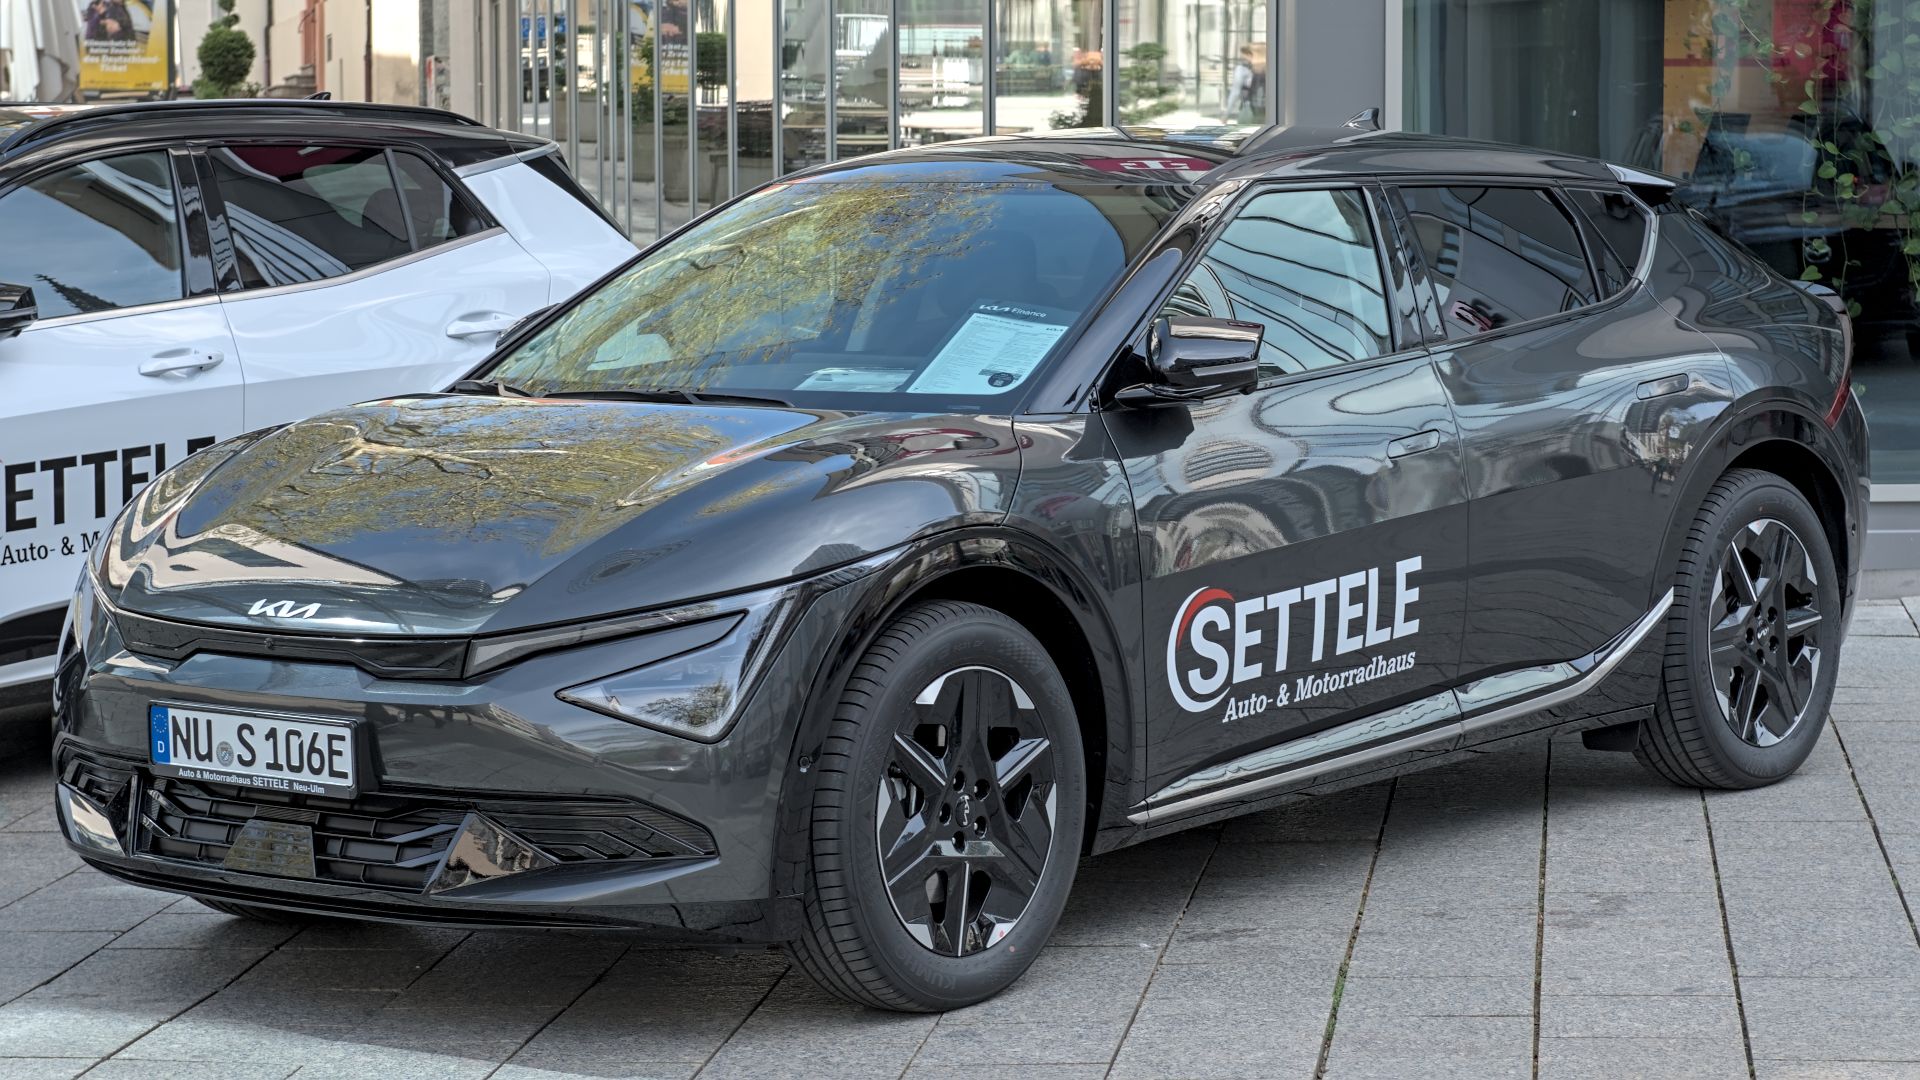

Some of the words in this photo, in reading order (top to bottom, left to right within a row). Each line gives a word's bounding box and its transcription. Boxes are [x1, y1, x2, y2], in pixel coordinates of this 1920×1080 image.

[1011, 307, 1048, 318] Finance
[0, 542, 56, 566] Auto-
[61, 536, 75, 556] &
[1187, 555, 1422, 695] SETTELE
[1222, 692, 1273, 723] Auto-
[1276, 683, 1289, 708] &
[1294, 651, 1416, 702] Motorradhaus
[157, 740, 165, 754] D
[171, 715, 212, 763] NU
[237, 723, 257, 768] S
[264, 727, 349, 780] 106E
[178, 768, 195, 779] Auto
[195, 770, 202, 779] &
[203, 771, 251, 785] Motorradhaus
[252, 776, 289, 790] SETTELE
[293, 782, 325, 795] Neu-Ulm
